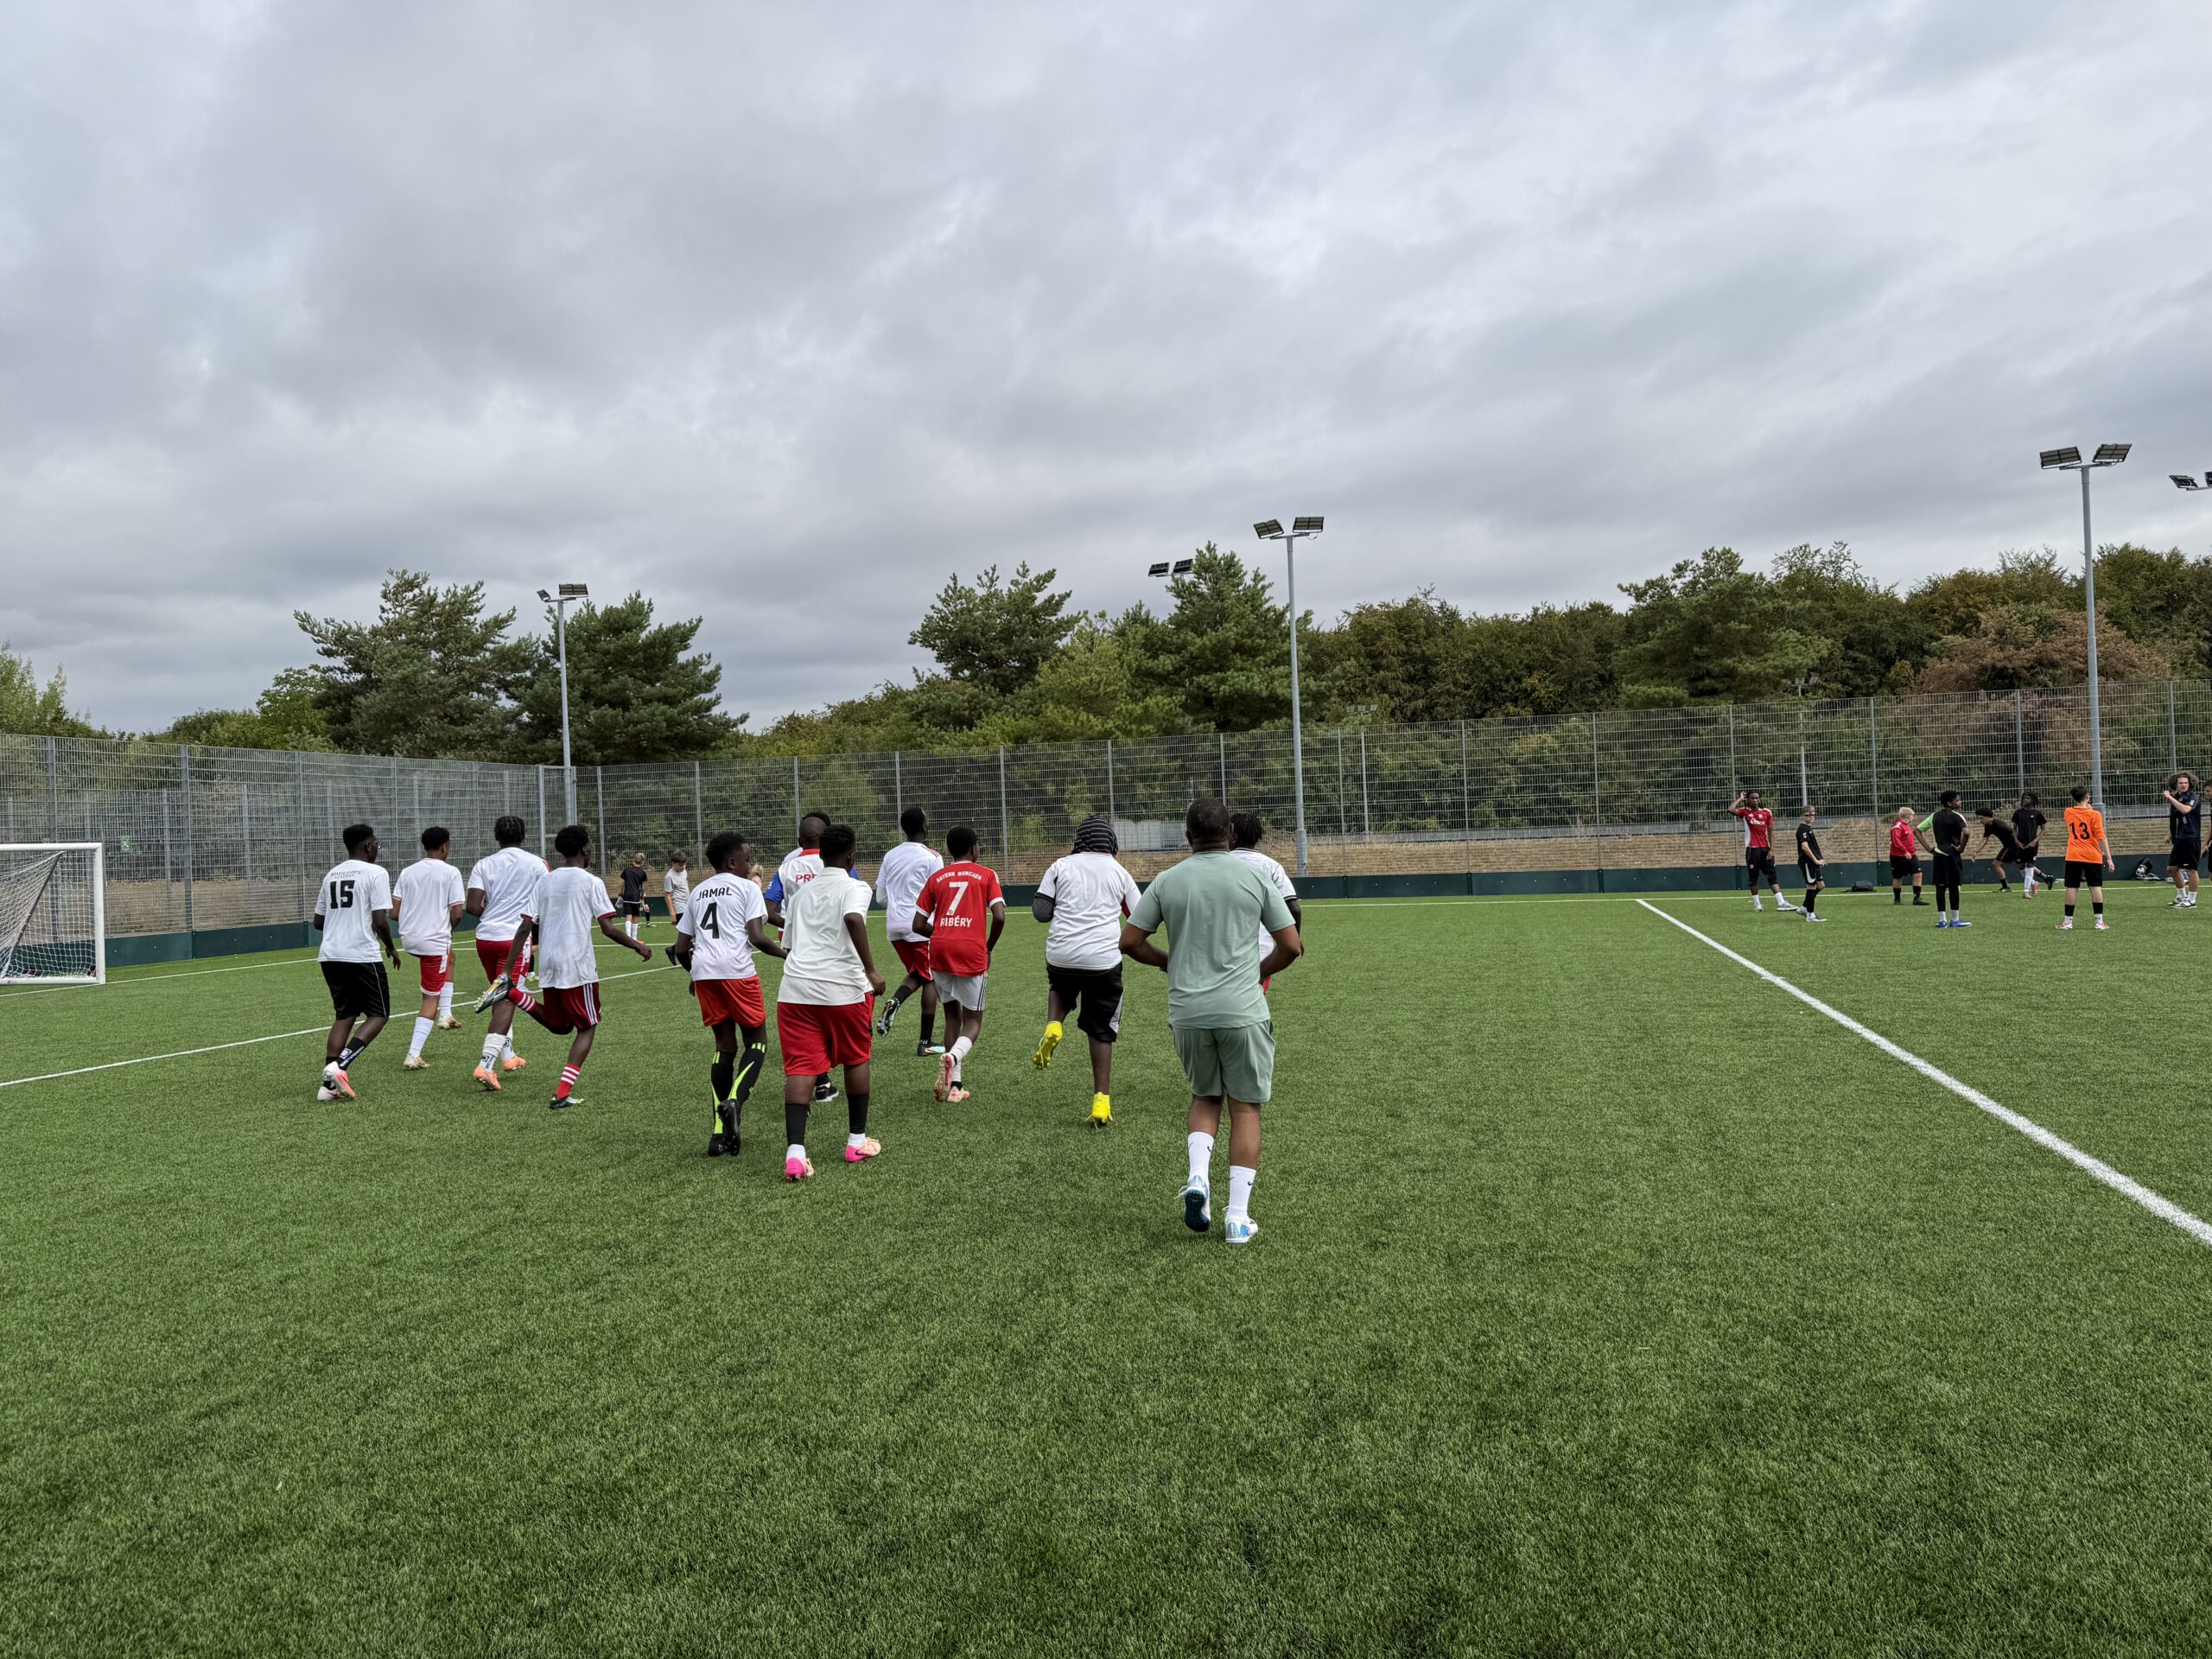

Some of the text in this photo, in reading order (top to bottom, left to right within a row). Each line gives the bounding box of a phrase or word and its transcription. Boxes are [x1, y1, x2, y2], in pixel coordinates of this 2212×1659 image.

[2069, 822, 2090, 840] 13
[936, 872, 955, 883] BAYERN
[330, 880, 355, 910] 15
[696, 887, 732, 901] JAMAL
[946, 881, 969, 916] 7
[700, 901, 720, 939] 4
[939, 915, 972, 928] RIBÉRY
